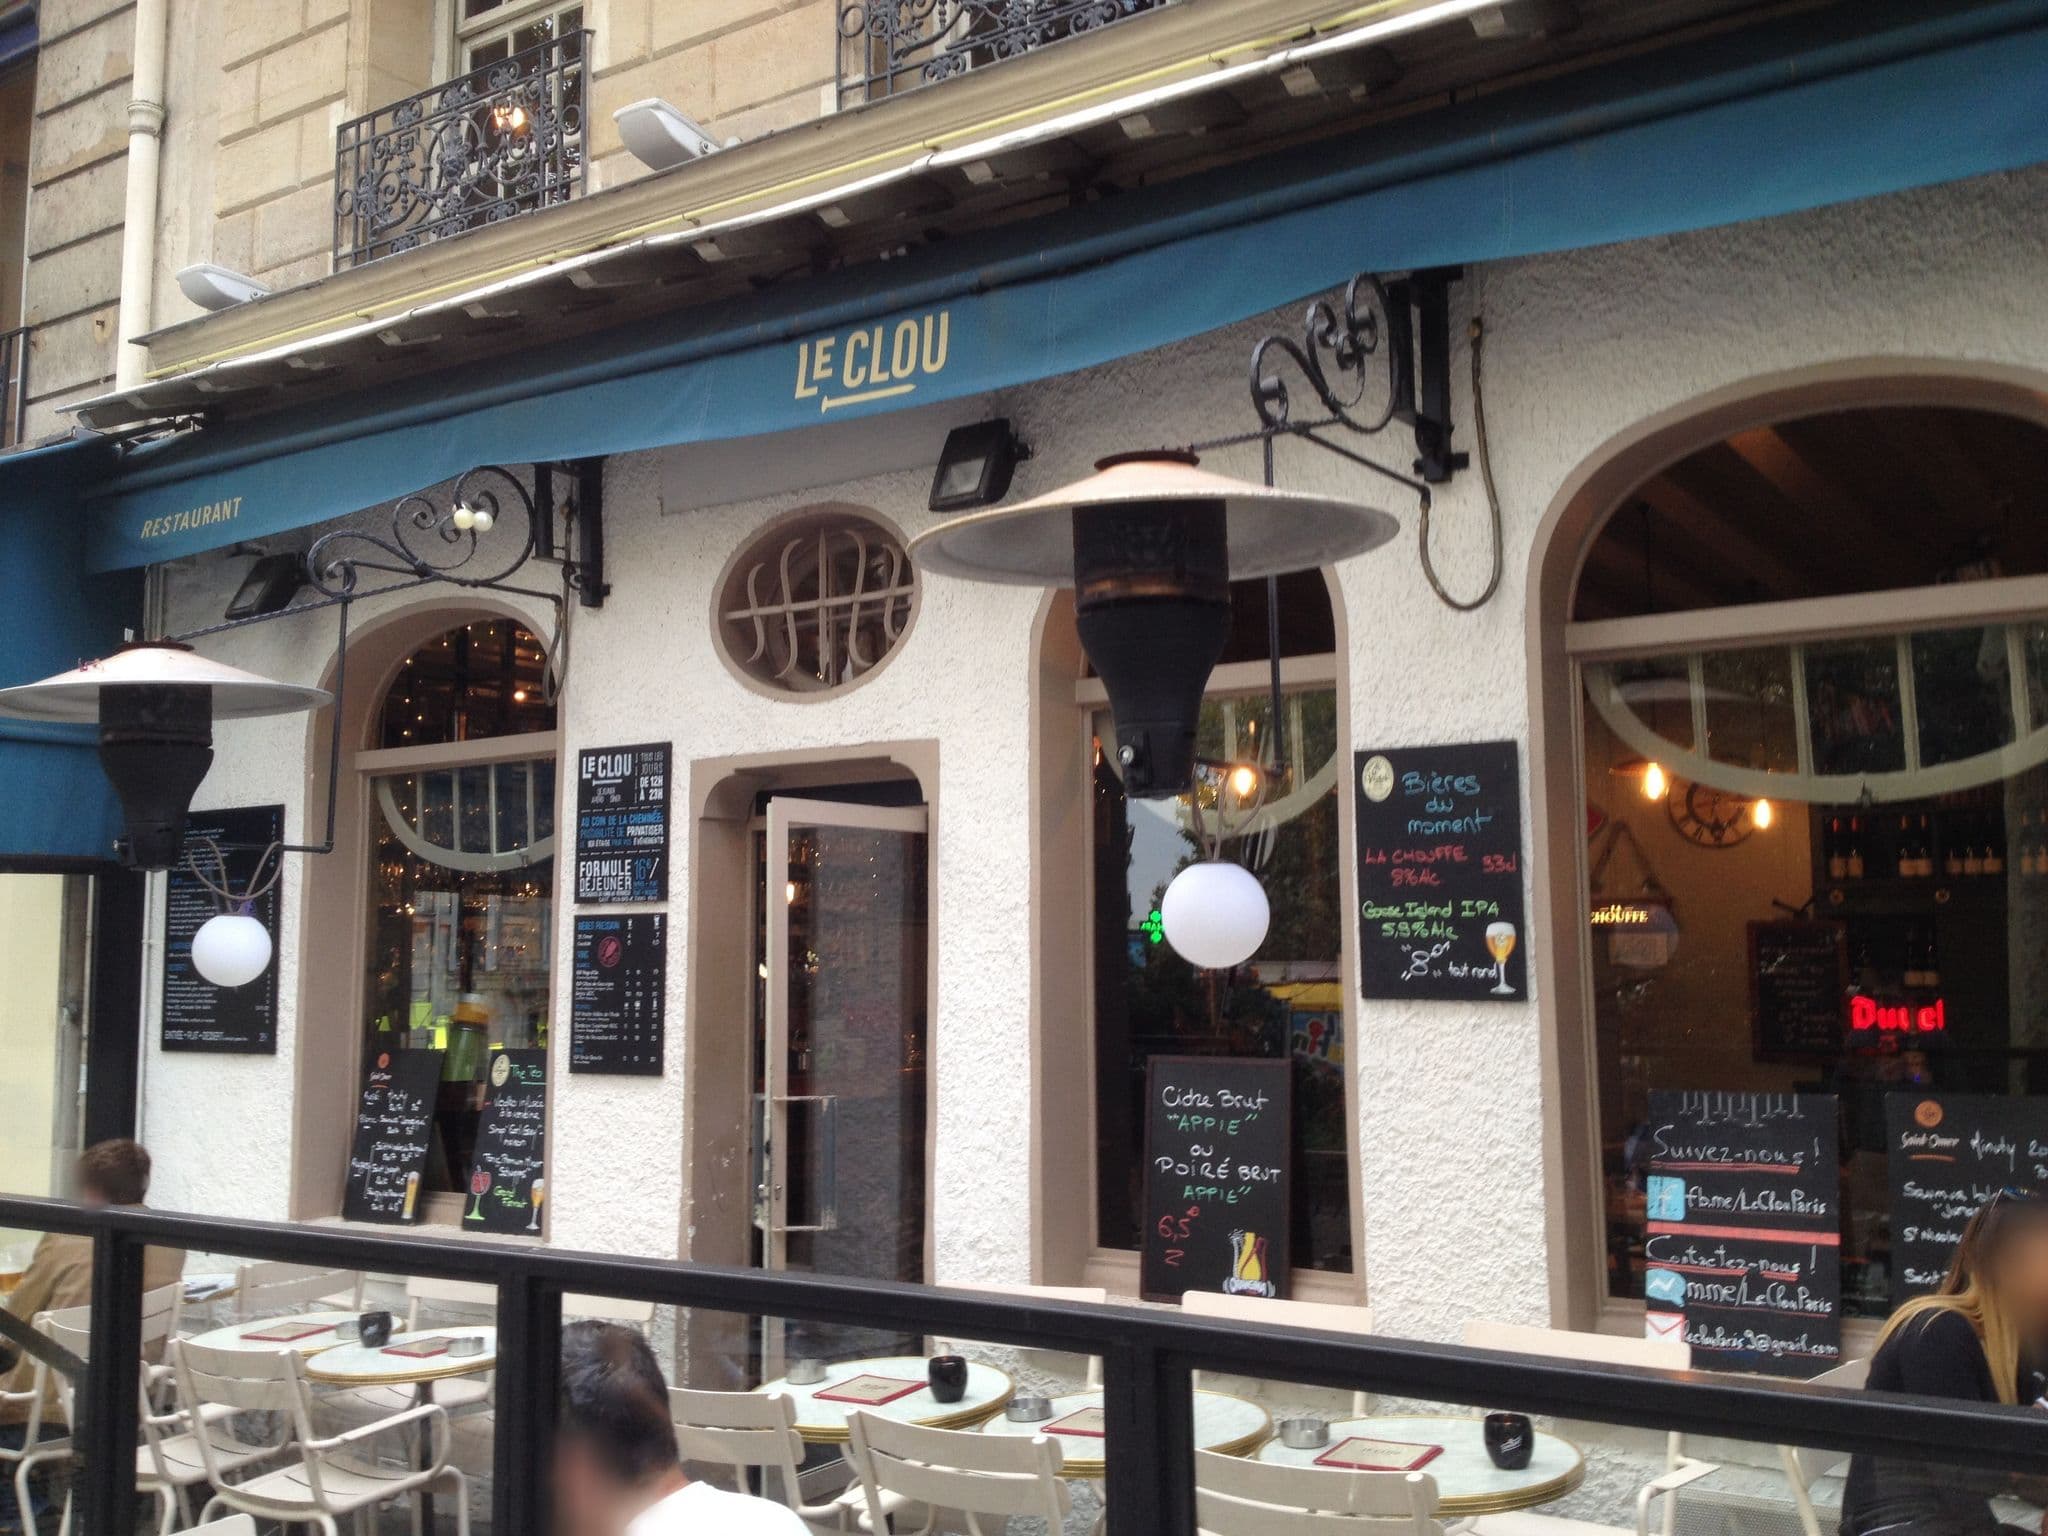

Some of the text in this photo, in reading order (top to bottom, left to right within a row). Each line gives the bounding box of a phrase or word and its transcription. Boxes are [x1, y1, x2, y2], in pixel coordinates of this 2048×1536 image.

[794, 311, 949, 399] LE CLOU
[140, 496, 243, 539] RESTAURANT
[582, 753, 632, 779] LE CLOU
[640, 775, 664, 787] DE 12H
[1401, 770, 1481, 796] Bières
[1424, 796, 1455, 813] du
[1408, 808, 1494, 835] moment
[1365, 848, 1387, 865] LA
[579, 859, 632, 878] FORMULE
[1461, 900, 1500, 918] IPA
[1162, 1085, 1270, 1110] Cidre Brut
[1238, 1165, 1282, 1184] BRUT
